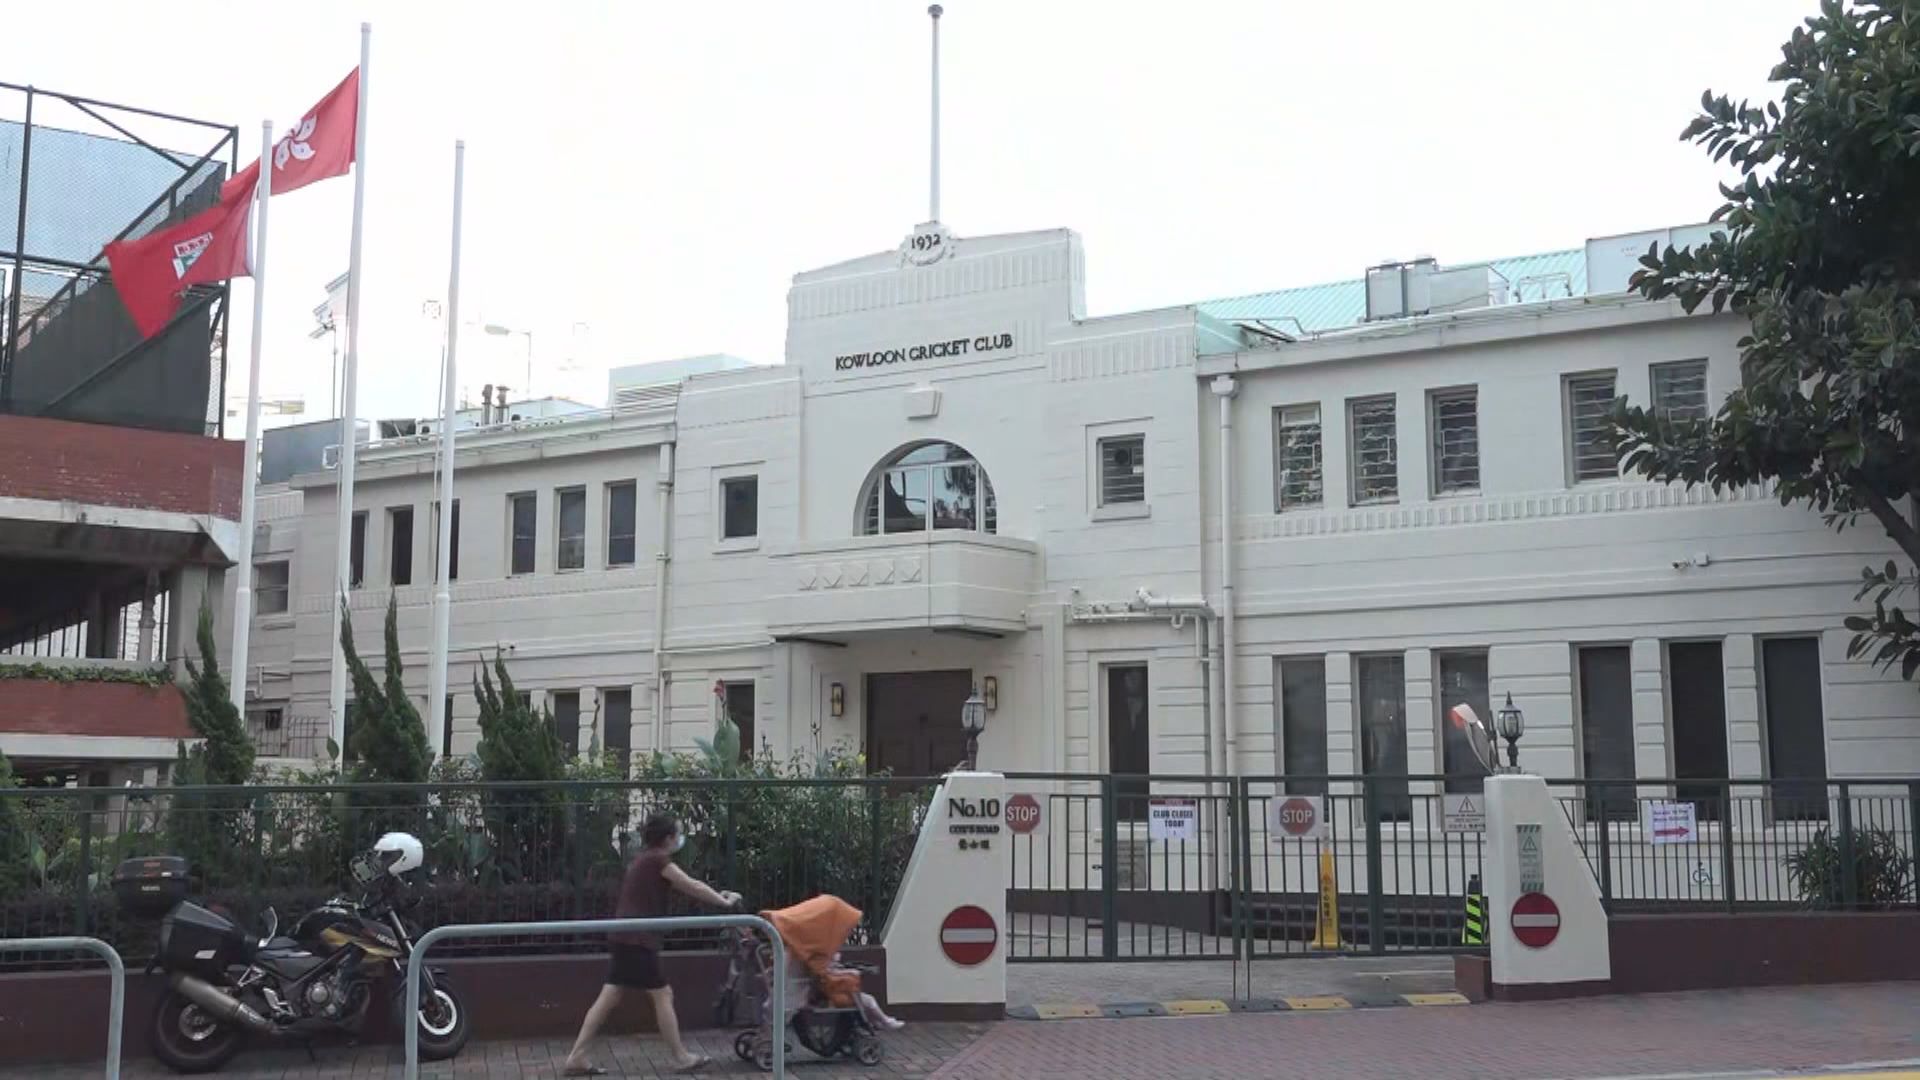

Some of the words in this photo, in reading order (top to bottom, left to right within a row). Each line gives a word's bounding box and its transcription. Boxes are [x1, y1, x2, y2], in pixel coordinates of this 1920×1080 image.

[911, 234, 940, 250] 1932
[835, 348, 907, 370] KOWLOON
[908, 339, 970, 361] CRICKET
[974, 334, 1013, 351] CLUB
[948, 798, 1000, 818] No.10
[1006, 806, 1038, 821] STOP
[1282, 809, 1313, 823] STOP
